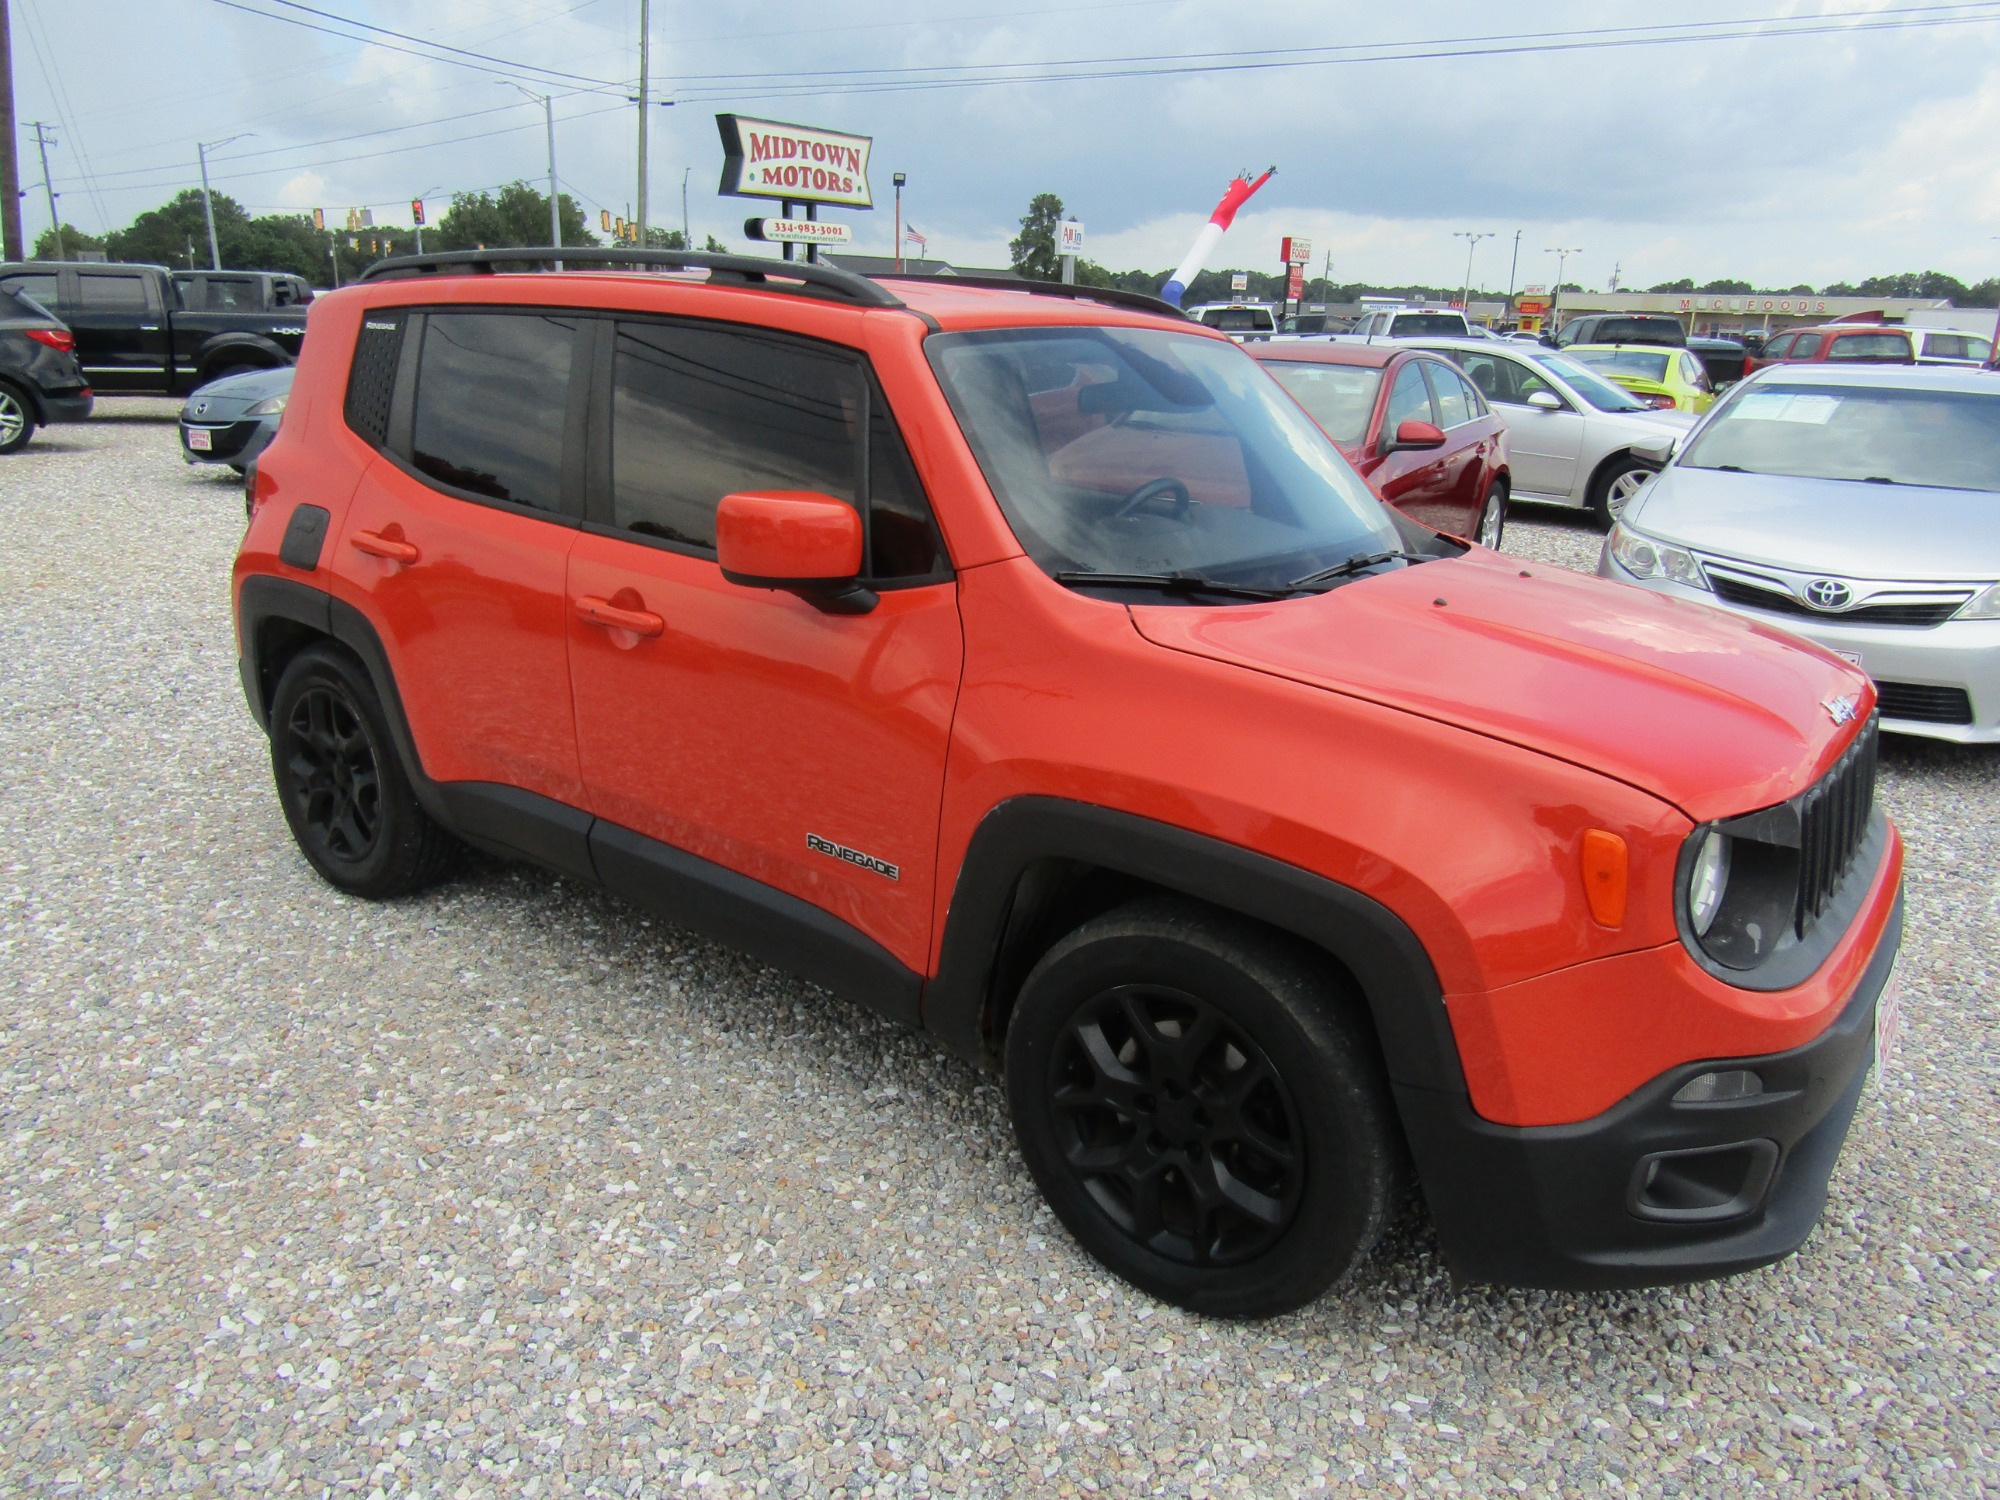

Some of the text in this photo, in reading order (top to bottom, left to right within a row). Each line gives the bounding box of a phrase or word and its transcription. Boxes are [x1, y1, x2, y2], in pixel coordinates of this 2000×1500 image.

[750, 132, 861, 176] MIDTOWN
[762, 165, 853, 193] MOTORS
[774, 222, 843, 236] 334-983-3001
[1062, 226, 1082, 244] All in
[1292, 248, 1311, 259] FOODS
[1747, 300, 1826, 311] FOODS
[806, 832, 899, 881] RENEGADE
